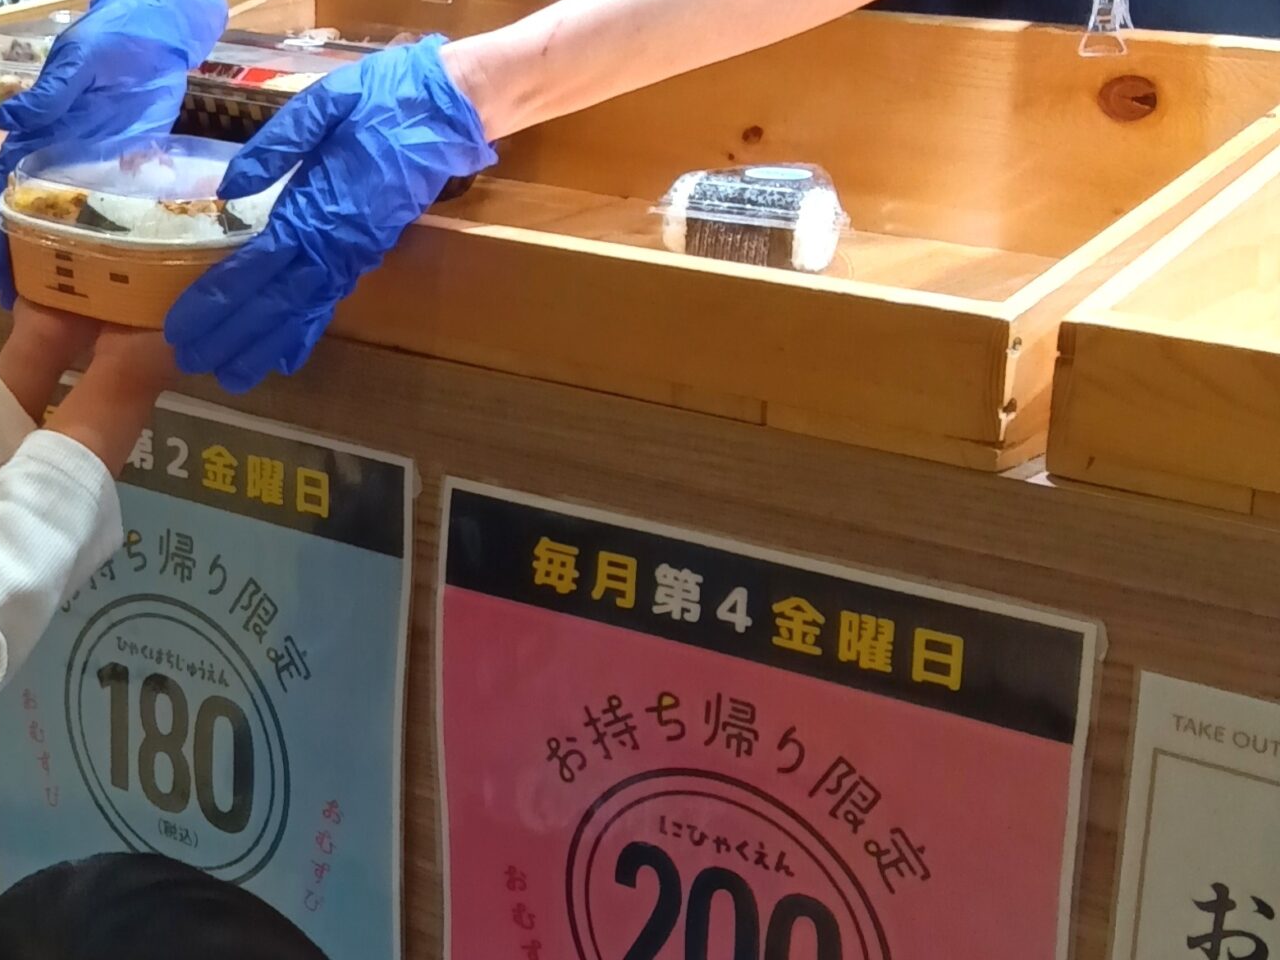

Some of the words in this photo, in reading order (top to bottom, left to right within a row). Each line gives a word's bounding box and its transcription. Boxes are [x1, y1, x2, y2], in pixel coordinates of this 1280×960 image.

[61, 527, 312, 693] ち帰り限定
[532, 536, 965, 691] 毎月第4金曜日
[96, 661, 255, 835] 180
[546, 691, 932, 895] お持ち帰り限定
[1172, 713, 1227, 744] TAKE
[659, 815, 795, 878] にひゃくえん
